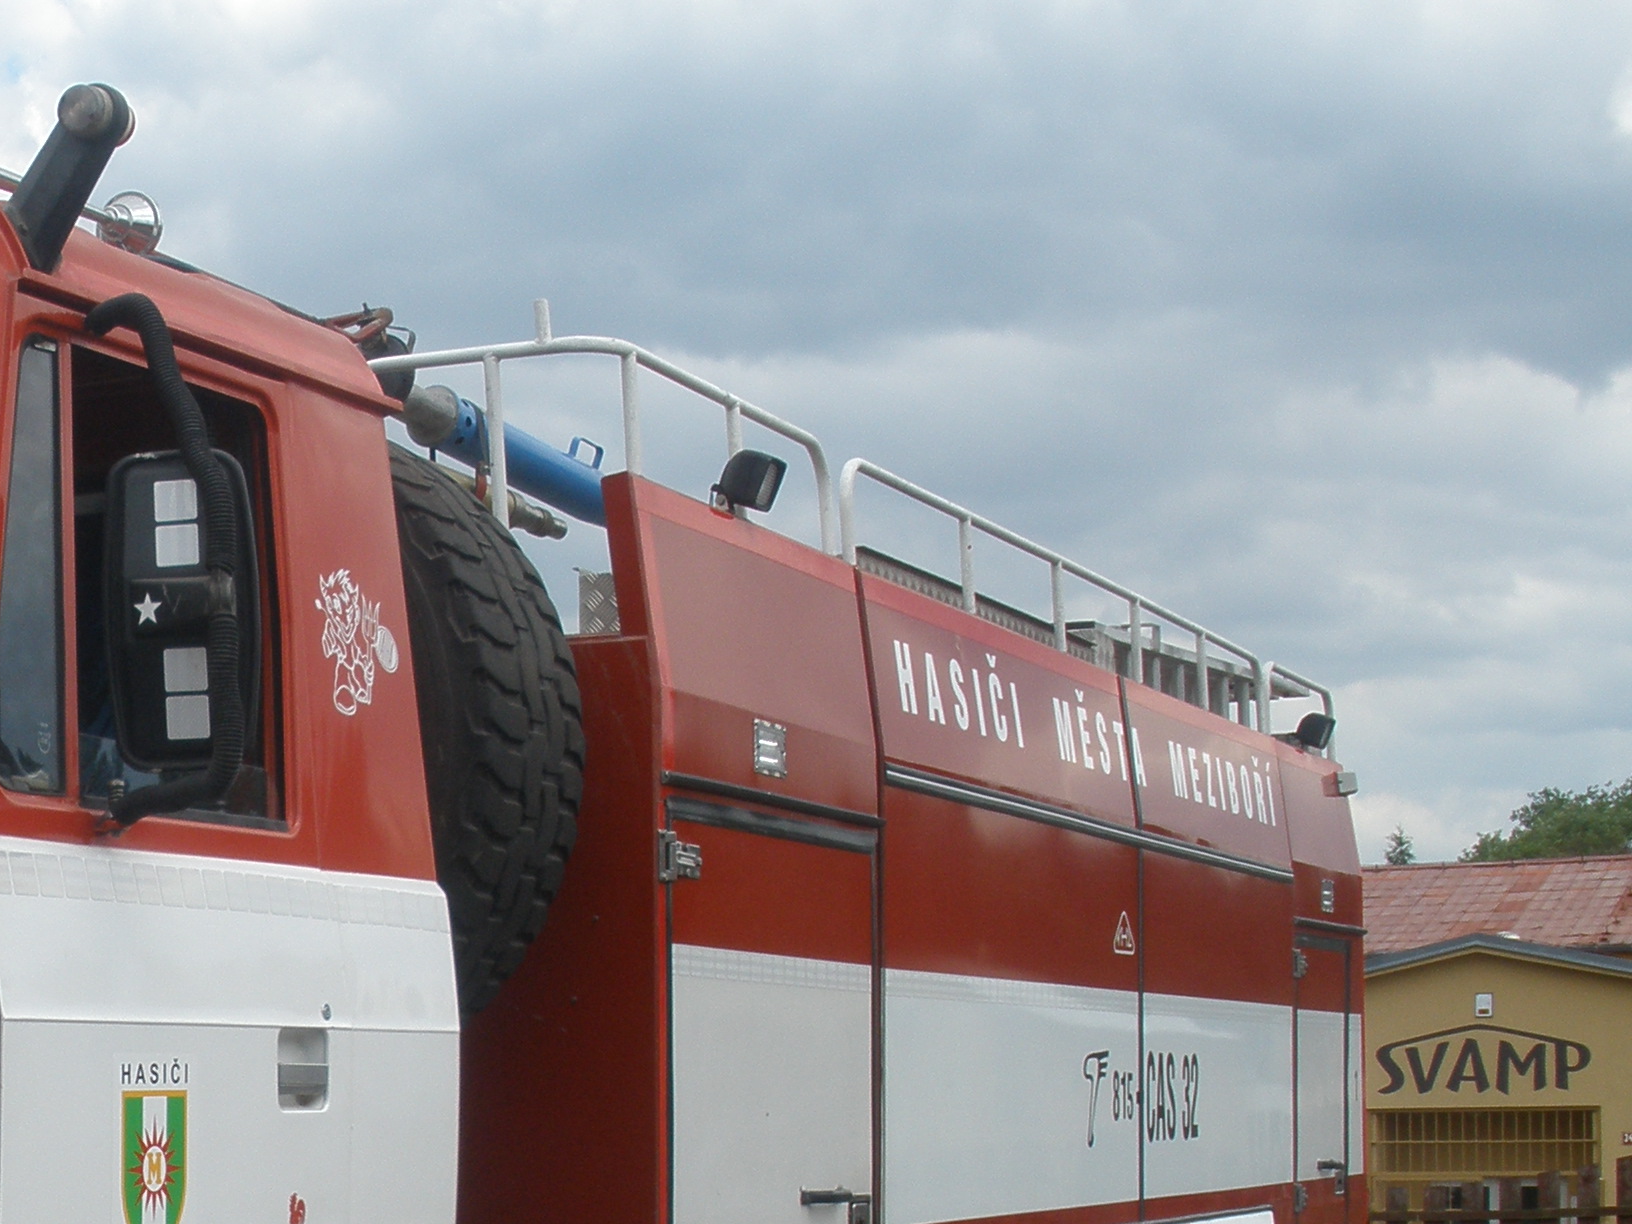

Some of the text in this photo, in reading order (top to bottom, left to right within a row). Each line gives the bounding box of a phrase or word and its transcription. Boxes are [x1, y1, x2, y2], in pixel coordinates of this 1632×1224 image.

[894, 640, 1276, 826] HASIČI MĚSTA MEZIBOŘÍ
[121, 1058, 188, 1084] HASIČI
[1376, 1024, 1591, 1095] SVAMP
[1182, 1053, 1198, 1140] 32
[147, 1152, 162, 1185] M
